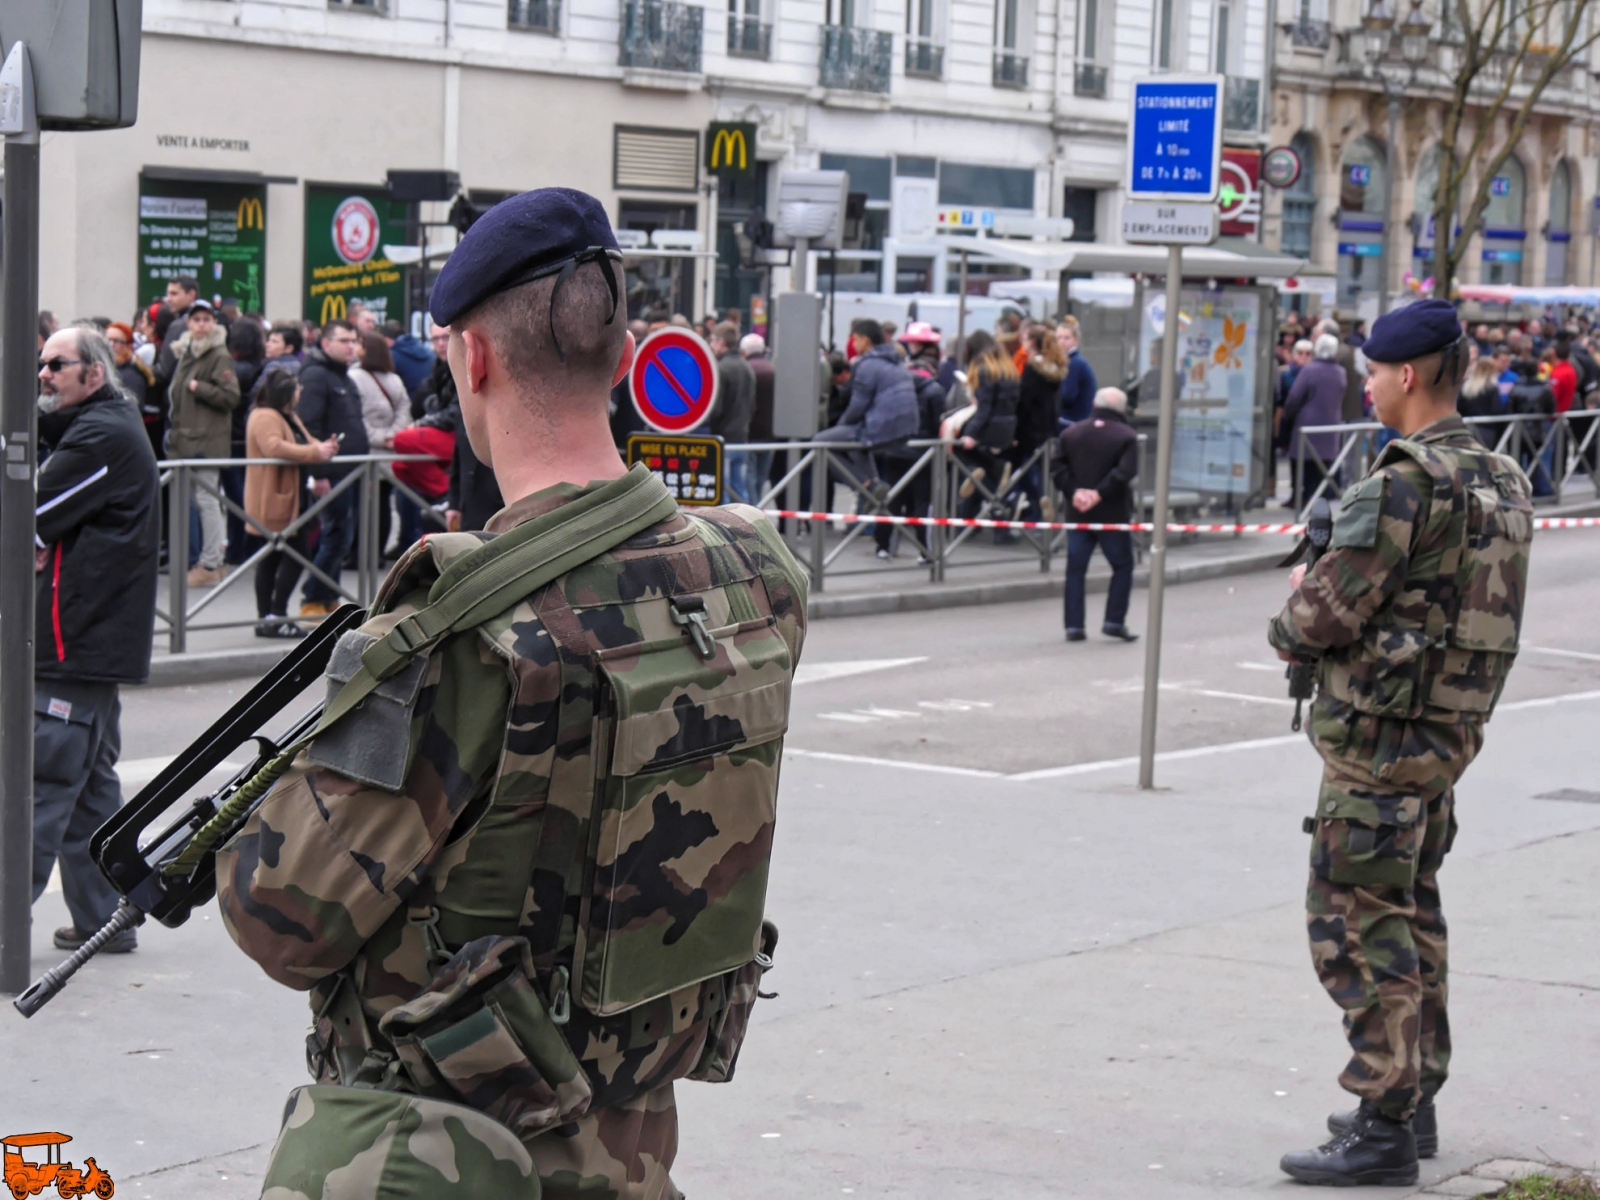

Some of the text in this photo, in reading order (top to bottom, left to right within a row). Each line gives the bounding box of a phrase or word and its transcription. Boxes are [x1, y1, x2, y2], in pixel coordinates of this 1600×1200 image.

[1138, 96, 1214, 109] STATIONNEMENT
[1158, 118, 1190, 133] LIMITÉ
[157, 134, 250, 153] VENTE A EMPORTER
[1141, 166, 1154, 179] DE
[1157, 208, 1176, 219] SUR
[1131, 223, 1209, 236] EMPLACEMENTS
[144, 255, 172, 266] Vendredi
[310, 278, 358, 297] partenaire
[361, 275, 373, 287] de
[640, 443, 707, 457] MISE EN PLACE
